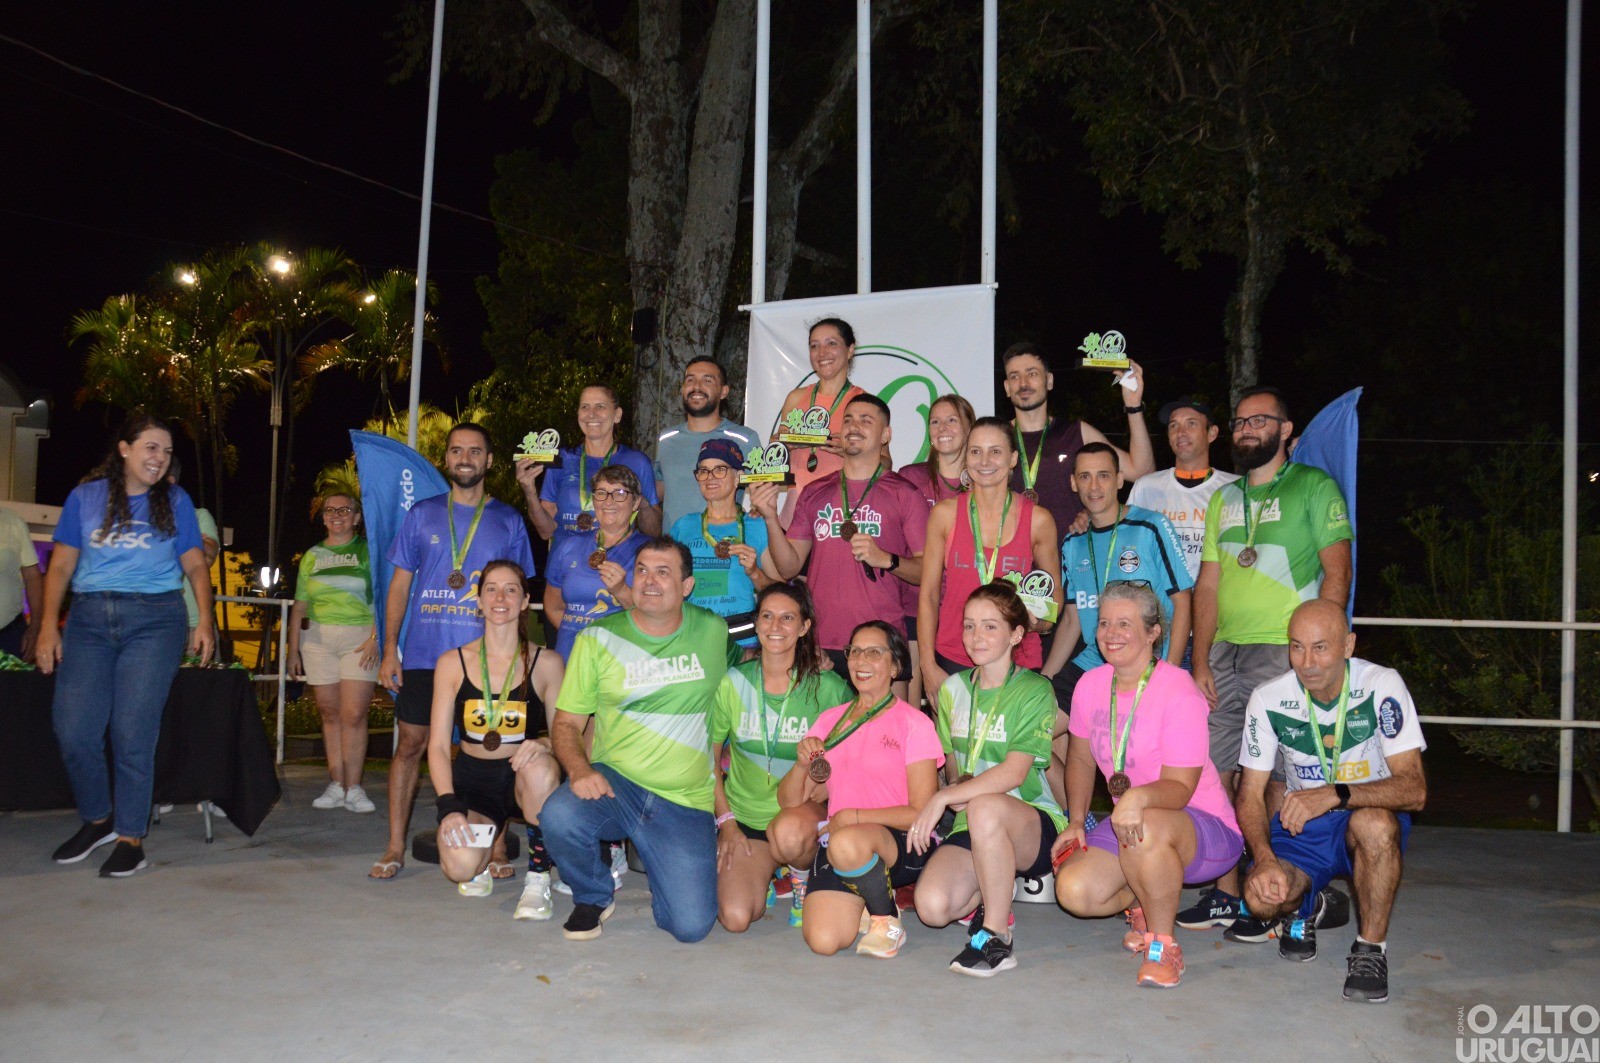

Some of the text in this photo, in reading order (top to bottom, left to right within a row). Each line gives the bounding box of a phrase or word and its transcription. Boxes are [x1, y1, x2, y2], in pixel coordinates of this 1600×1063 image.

[421, 589, 456, 599] ATLETA
[663, 671, 701, 683] PLANALTO
[1280, 700, 1299, 708] MTX
[472, 708, 521, 728] 39
[1210, 906, 1232, 918] FILA
